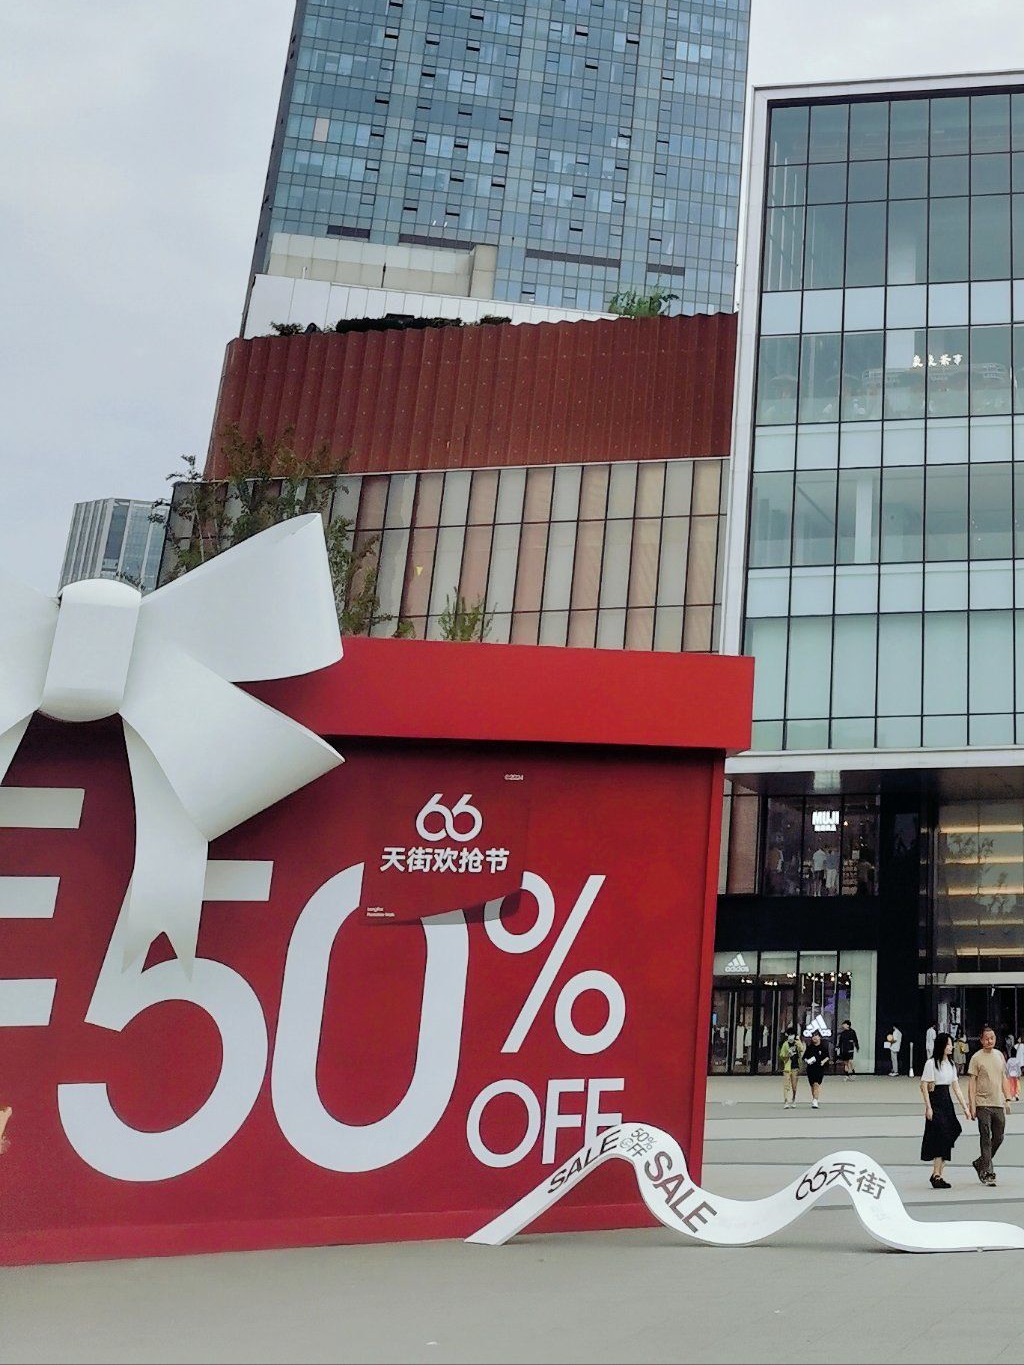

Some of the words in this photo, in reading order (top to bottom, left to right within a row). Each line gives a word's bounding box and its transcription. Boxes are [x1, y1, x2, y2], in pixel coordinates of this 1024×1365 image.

[415, 793, 483, 842] 66
[811, 810, 840, 825] MUJI
[380, 846, 510, 874] 天街欢抢节
[724, 965, 750, 973] adidas
[466, 1078, 626, 1168] OFF
[630, 1127, 658, 1151] 50%
[547, 1128, 622, 1194] SALE
[643, 1150, 718, 1234] SALE
